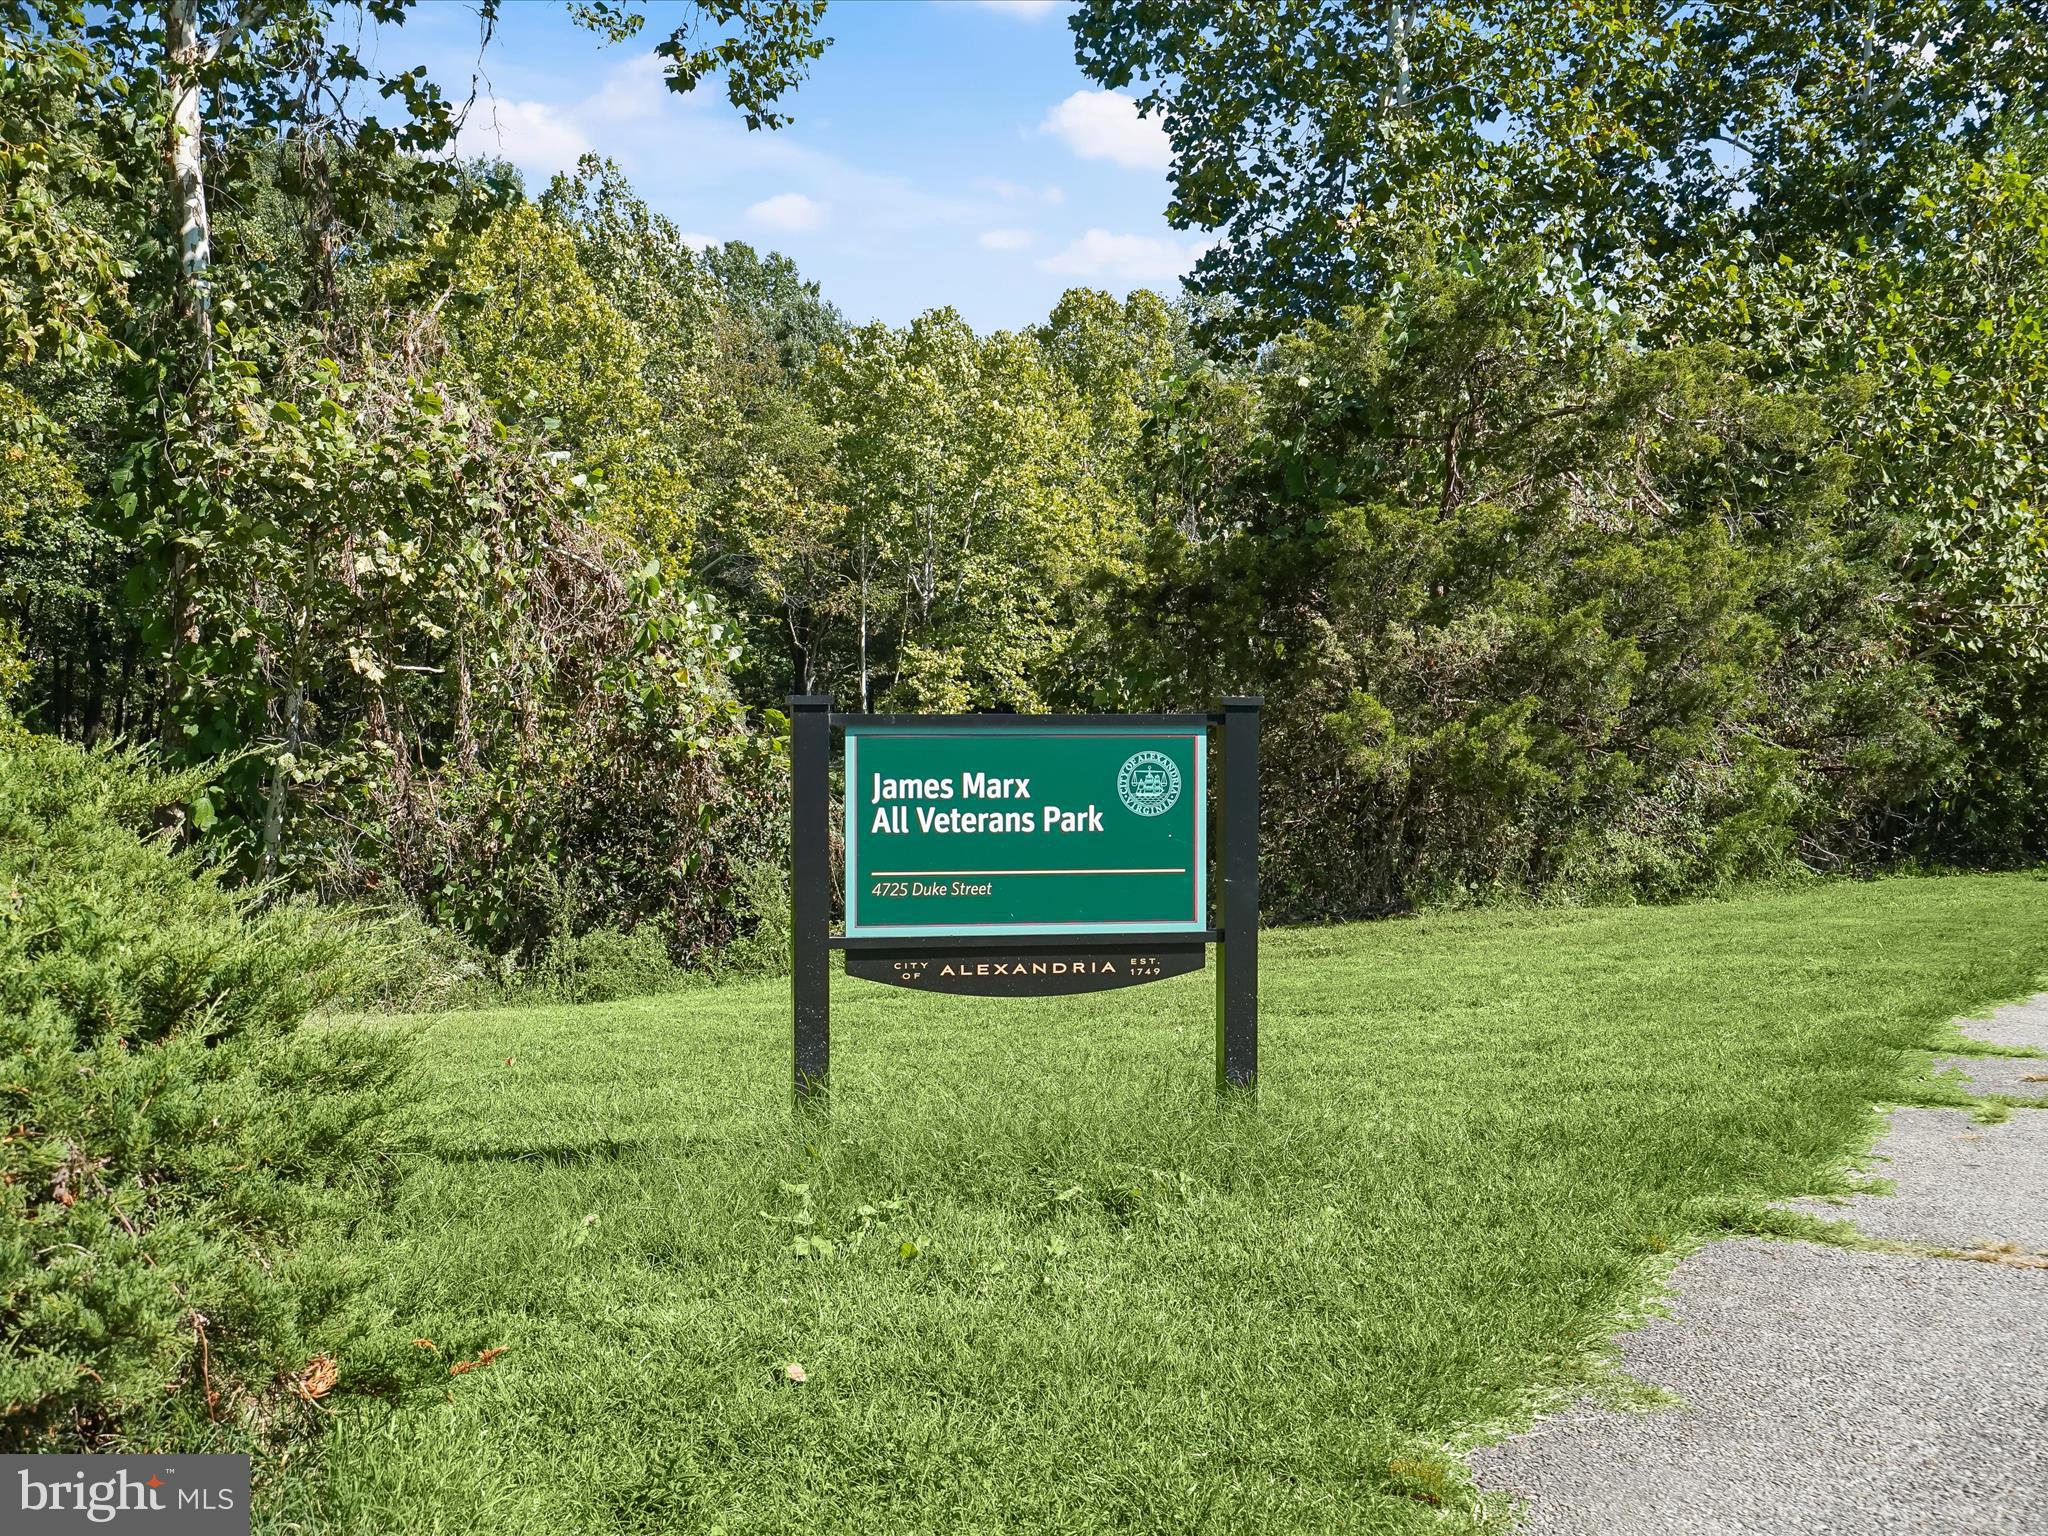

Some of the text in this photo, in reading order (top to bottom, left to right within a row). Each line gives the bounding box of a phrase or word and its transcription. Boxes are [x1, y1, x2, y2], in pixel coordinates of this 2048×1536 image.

[871, 772, 1031, 804] James Marx
[871, 804, 1104, 834] All Veterans Park
[871, 881, 993, 897] 4725 Duke Street
[893, 962, 929, 970] CITY
[1130, 957, 1161, 965] EST.
[939, 961, 1117, 977] ALEXANDRIA
[1130, 967, 1161, 976] 1749
[902, 972, 922, 980] OF
